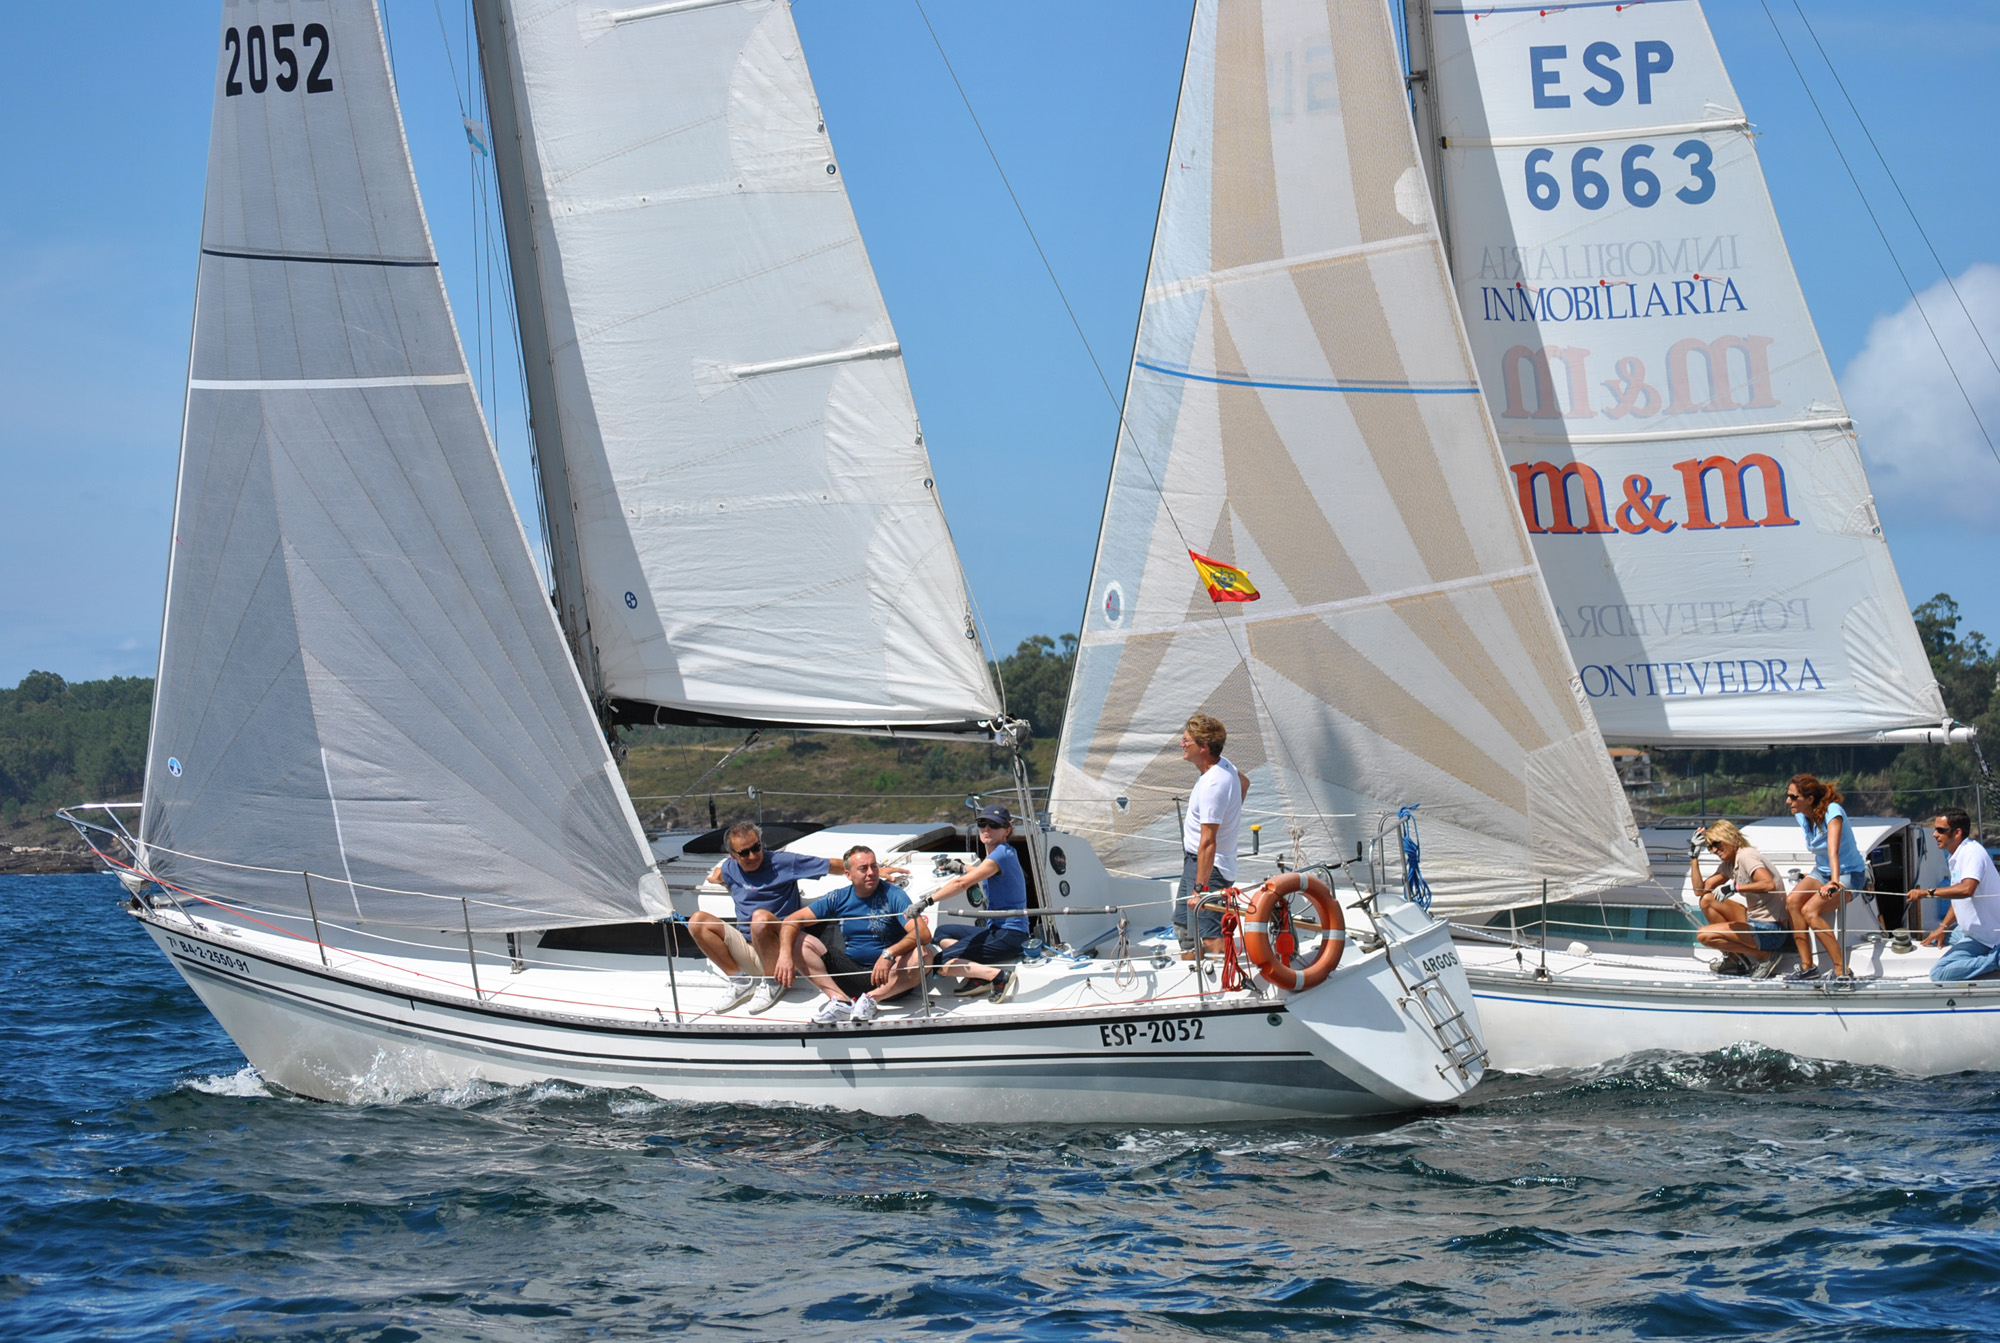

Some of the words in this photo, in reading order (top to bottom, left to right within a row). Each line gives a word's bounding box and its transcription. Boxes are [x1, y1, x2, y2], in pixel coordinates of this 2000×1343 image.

[225, 23, 333, 97] 2052
[1529, 40, 1674, 109] ESP
[1525, 140, 1716, 211] 6663
[1481, 277, 1748, 322] INMOBILIARIA
[1510, 453, 1800, 534] m&m
[1580, 658, 1826, 697] ONTEVEDRA
[1422, 952, 1458, 972] ARGOS
[1099, 1018, 1205, 1047] ESP-2052
